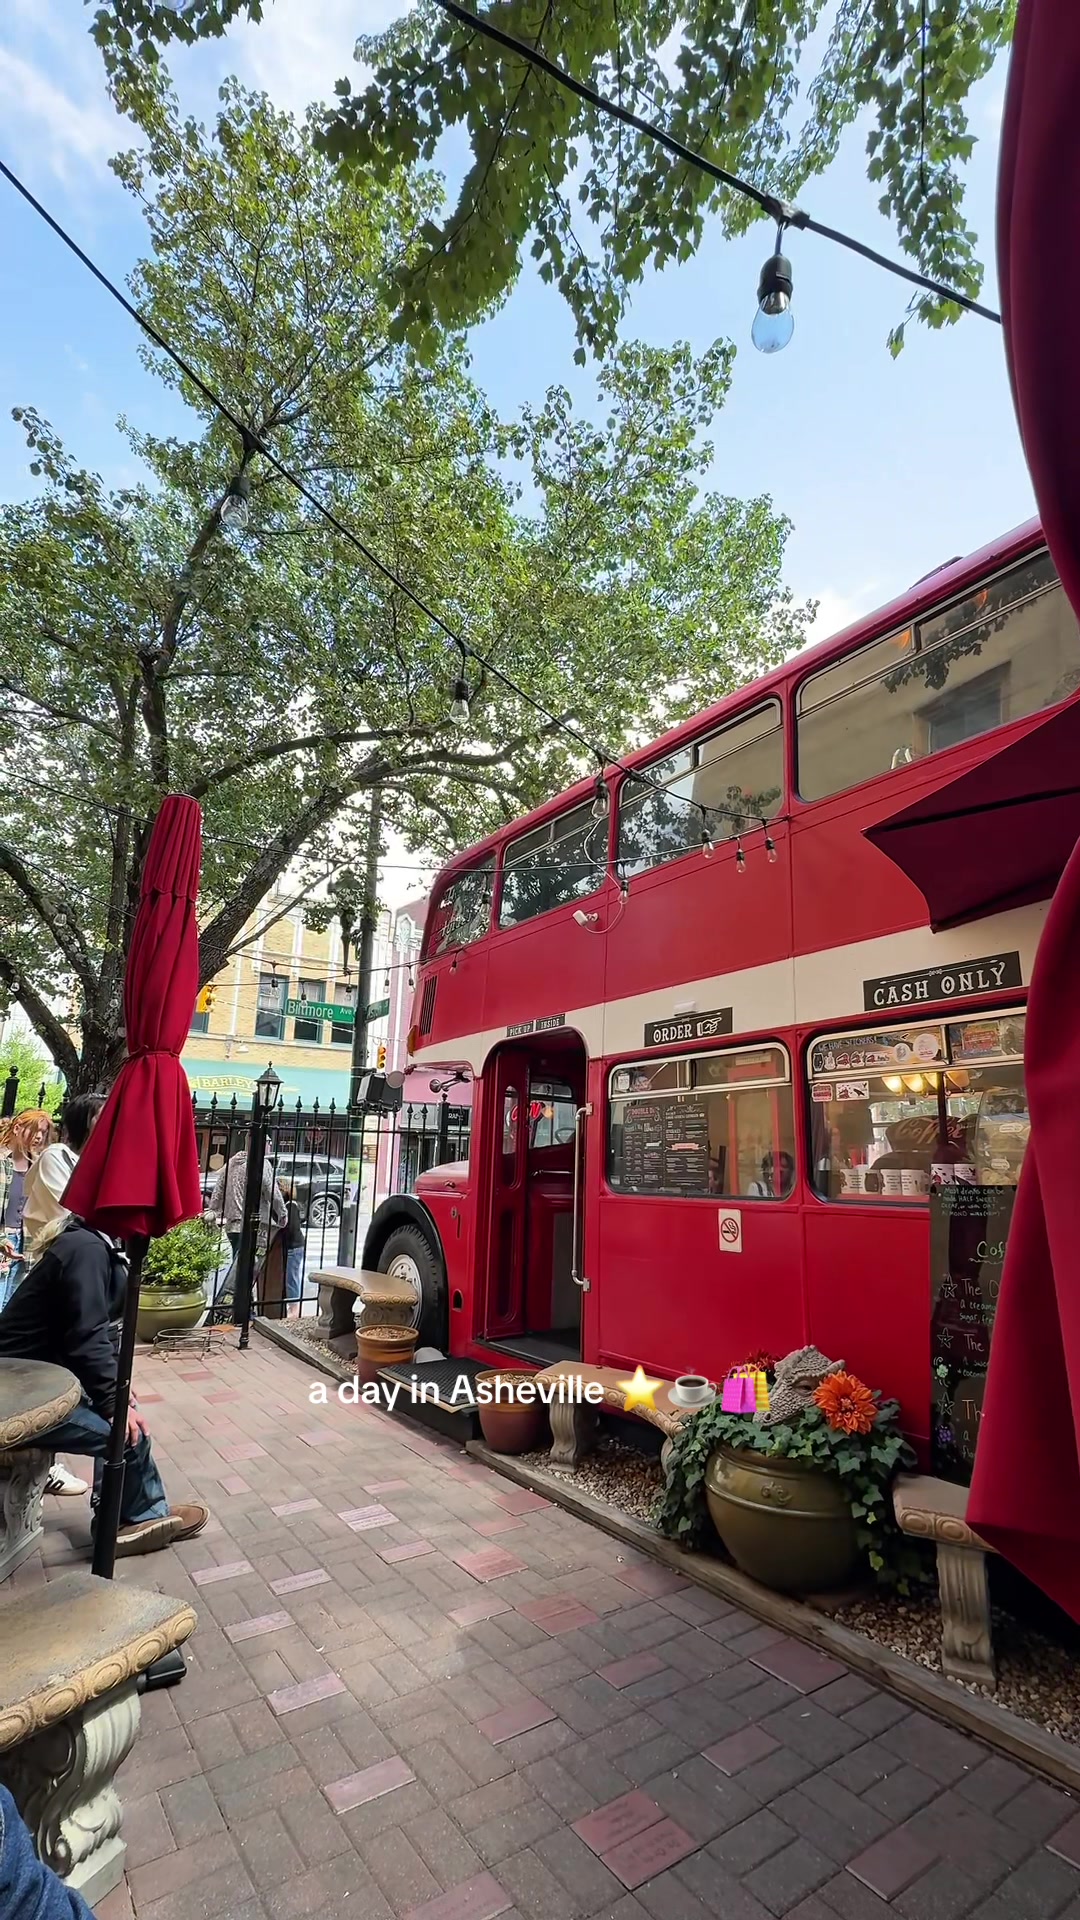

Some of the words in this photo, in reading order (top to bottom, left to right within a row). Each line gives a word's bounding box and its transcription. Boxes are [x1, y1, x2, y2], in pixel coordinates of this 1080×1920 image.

[873, 980, 929, 1006] CASH
[940, 961, 1006, 995] ONLY
[287, 1000, 334, 1019] Biltmore
[339, 1007, 353, 1016] Ave
[509, 1027, 522, 1036] PICK
[523, 1025, 531, 1033] UP
[540, 1018, 560, 1029] INSIDE
[653, 1023, 692, 1043] ORDER
[202, 1077, 257, 1089] BARLEY
[976, 1240, 1005, 1259] Cof
[961, 1278, 982, 1297] The
[963, 1333, 985, 1352] The
[961, 1399, 984, 1422] Th
